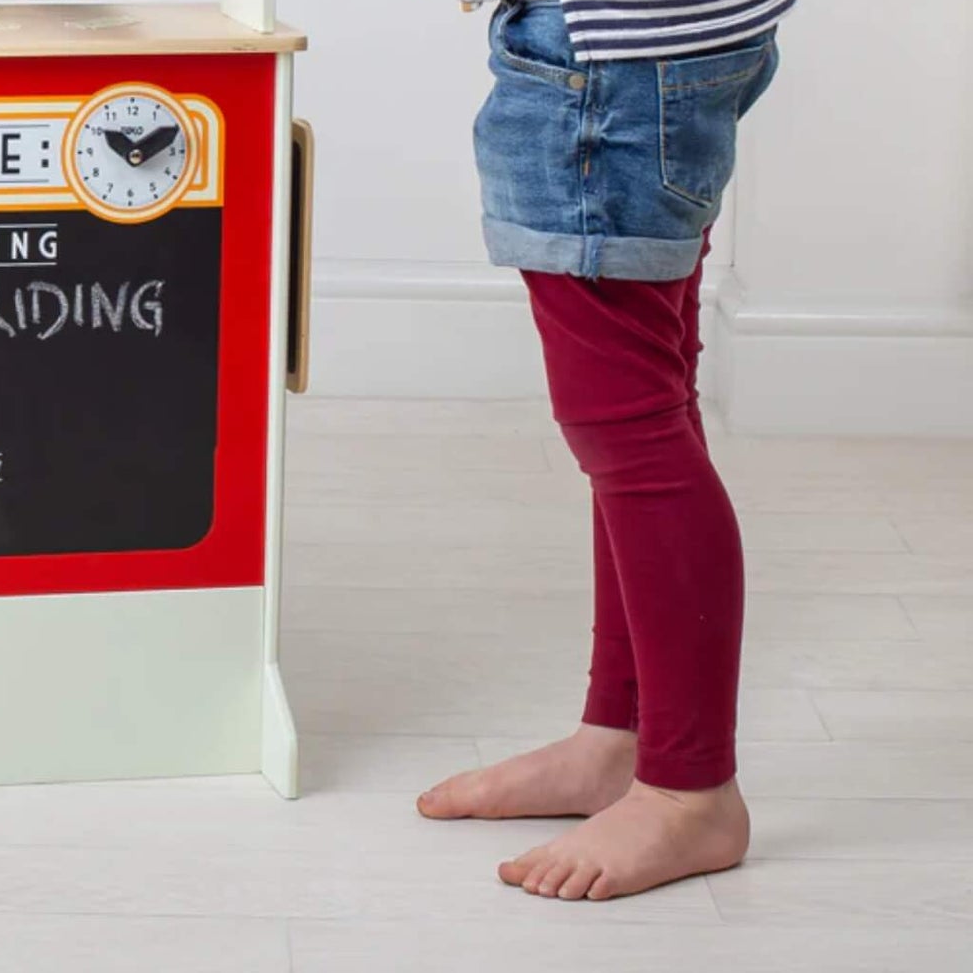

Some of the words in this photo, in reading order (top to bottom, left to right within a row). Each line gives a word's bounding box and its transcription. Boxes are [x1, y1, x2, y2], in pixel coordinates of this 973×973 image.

[127, 106, 139, 116] 12
[106, 112, 116, 121] 11
[91, 127, 103, 136] 10
[86, 147, 93, 157] 9
[168, 146, 176, 157] 3
[92, 167, 100, 178] 8
[164, 166, 171, 176] 4
[107, 182, 114, 193] 7
[149, 182, 157, 192] 5
[127, 189, 134, 198] 6
